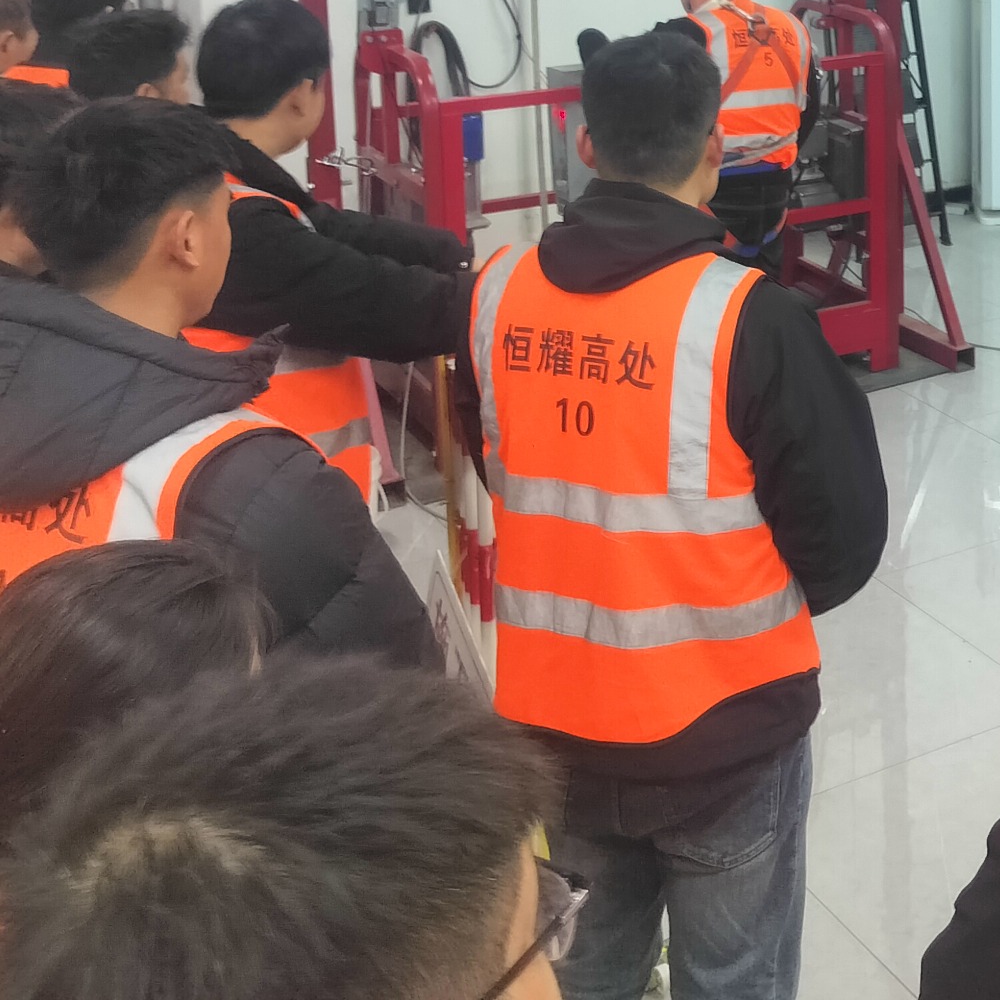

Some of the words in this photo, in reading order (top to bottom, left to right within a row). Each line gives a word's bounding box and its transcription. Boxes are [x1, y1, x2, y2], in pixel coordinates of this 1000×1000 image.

[731, 28, 796, 48] 恒处
[764, 52, 774, 67] 5
[503, 324, 656, 390] 恒耀高处
[556, 398, 595, 436] 10
